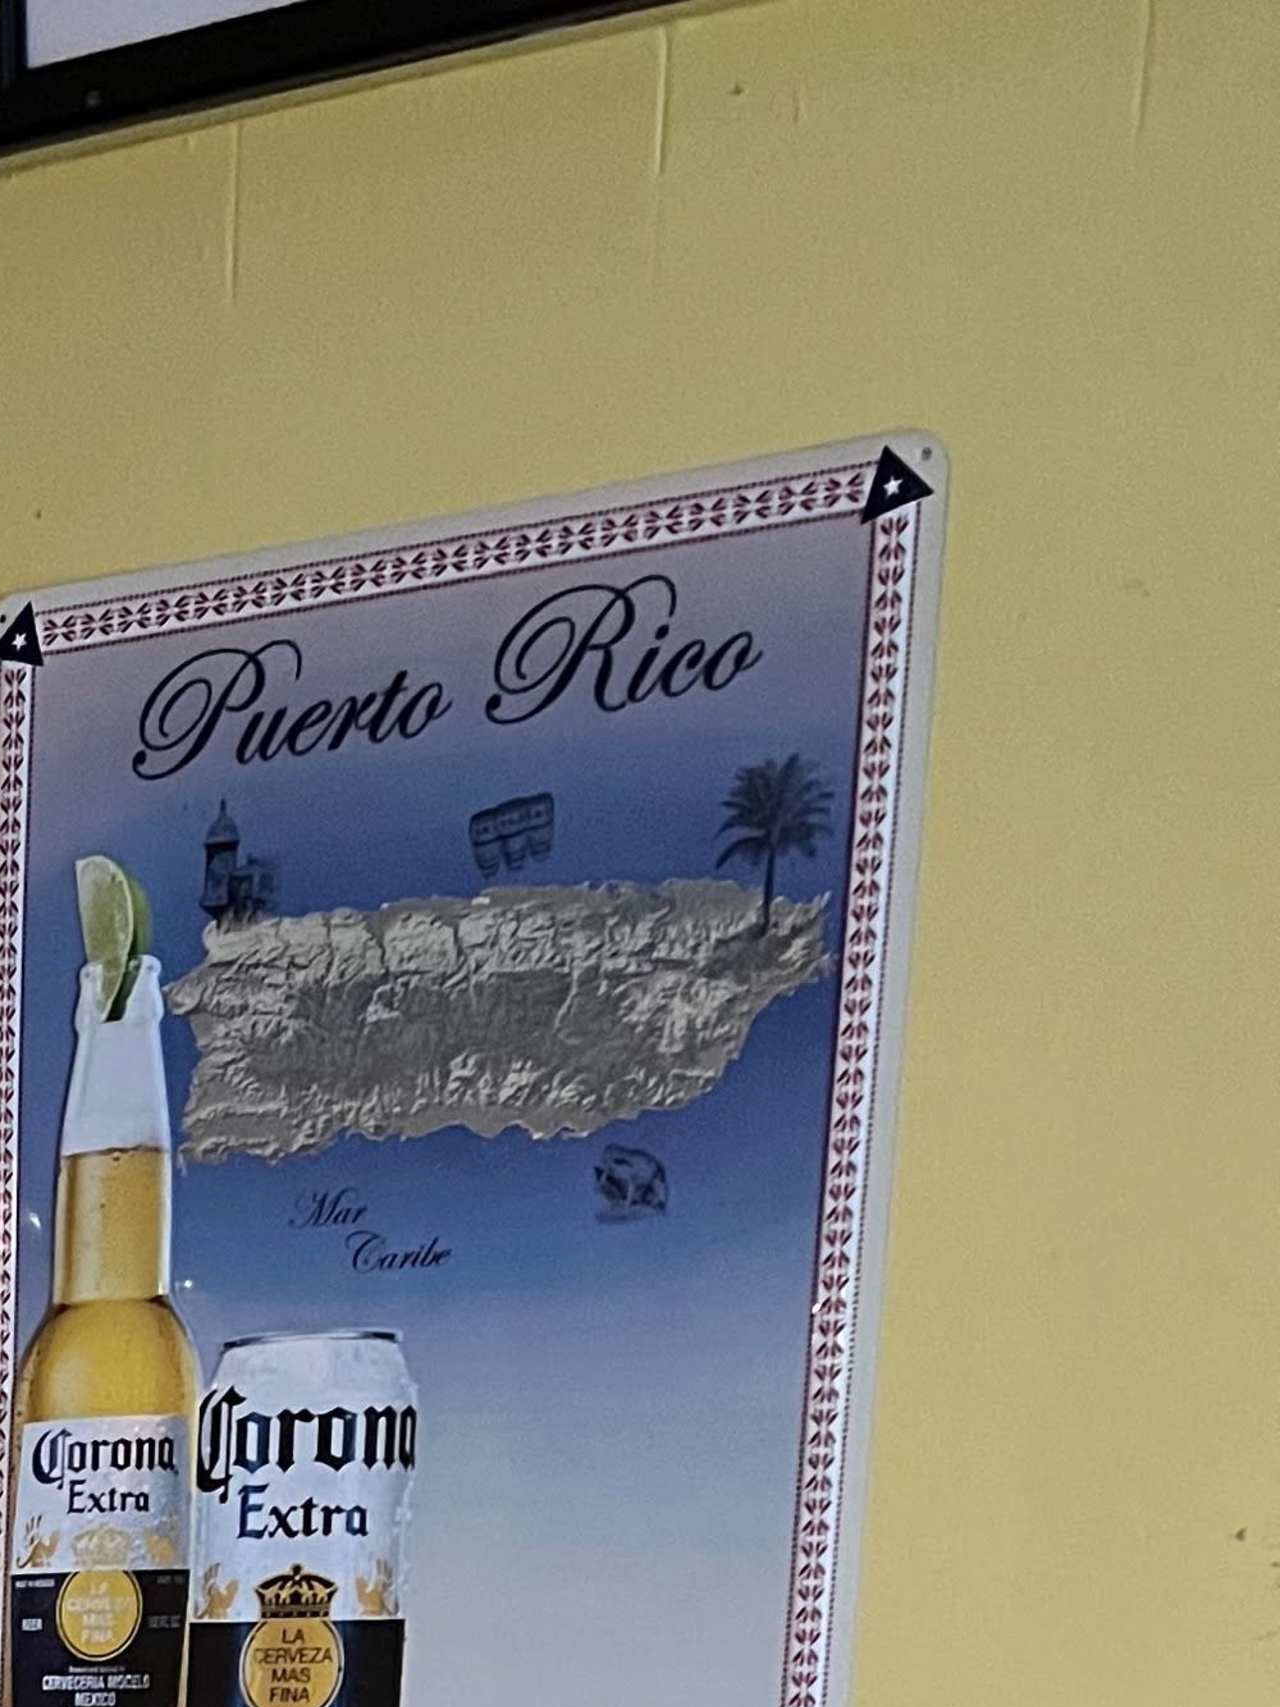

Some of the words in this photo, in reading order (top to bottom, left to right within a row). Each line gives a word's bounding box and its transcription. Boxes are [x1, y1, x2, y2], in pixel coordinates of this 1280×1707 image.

[132, 640, 452, 780] Puerto
[486, 575, 763, 726] Rico
[289, 1187, 368, 1229] Mar
[344, 1230, 453, 1274] Caribe
[32, 1428, 177, 1490] Corona
[196, 1384, 418, 1504] Corona
[66, 1479, 150, 1515] Extra
[236, 1483, 369, 1540] Extra
[256, 1648, 333, 1664] CERVEZA
[282, 1628, 304, 1643] LA
[269, 1687, 310, 1703] FINA
[271, 1668, 311, 1682] MAS
